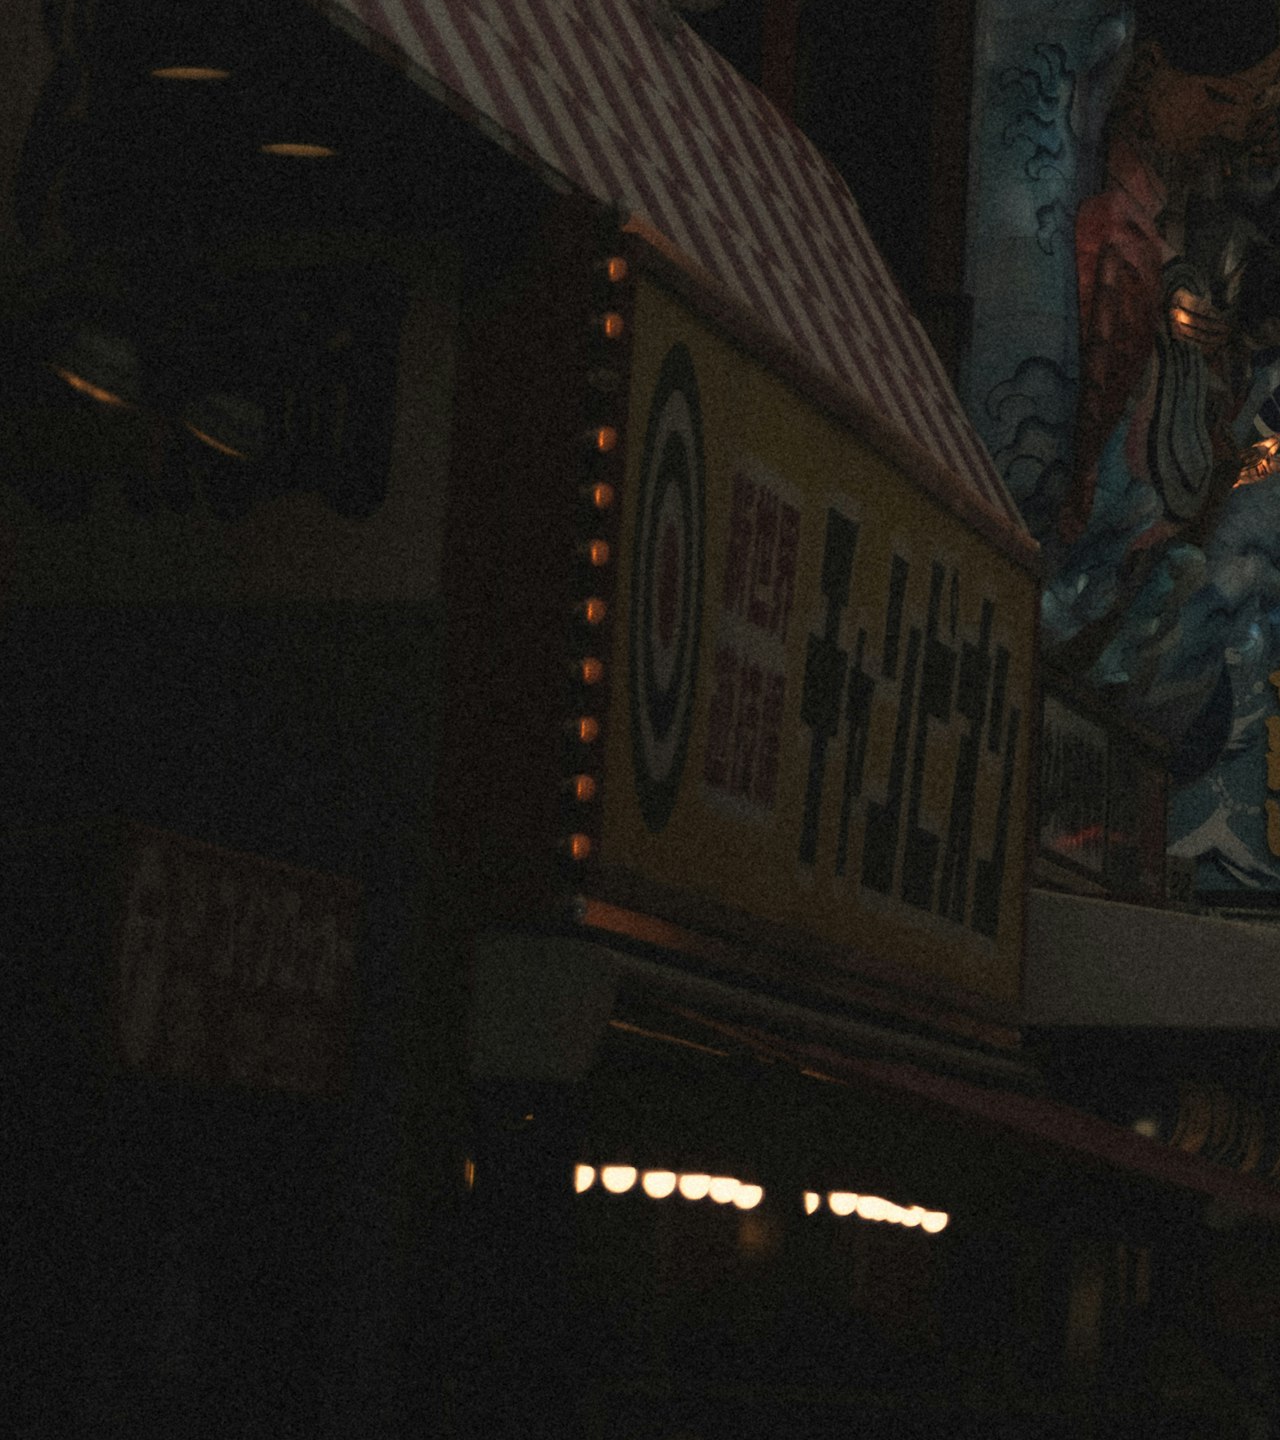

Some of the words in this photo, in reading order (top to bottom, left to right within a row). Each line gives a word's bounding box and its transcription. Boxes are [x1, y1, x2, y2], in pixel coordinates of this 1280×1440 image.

[796, 506, 1025, 940] チャンピオン
